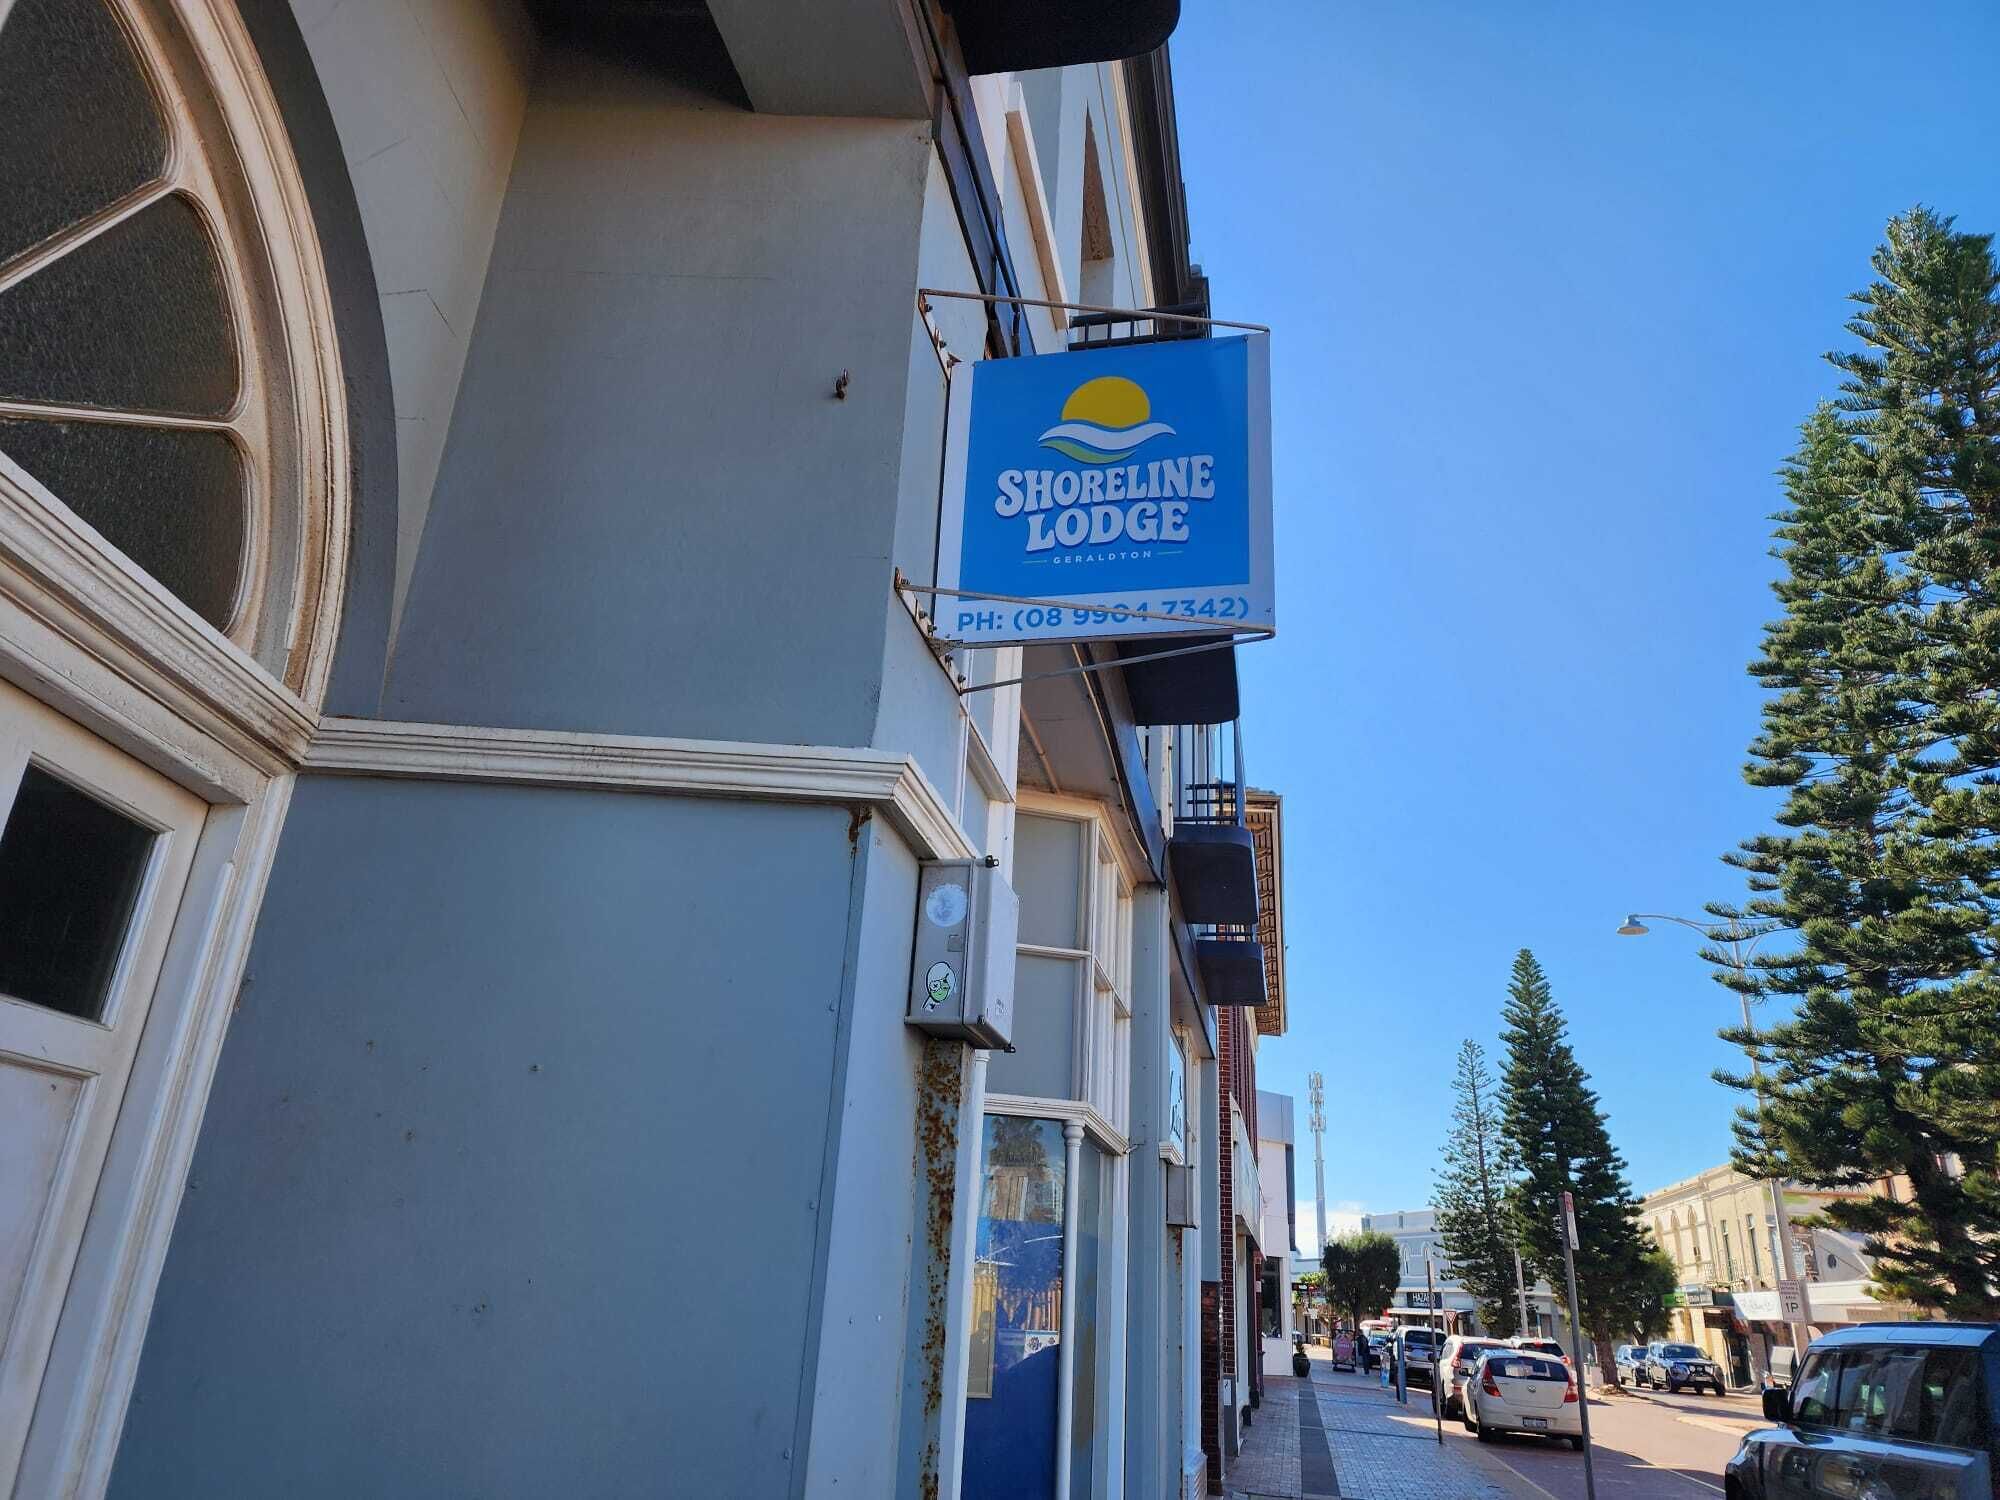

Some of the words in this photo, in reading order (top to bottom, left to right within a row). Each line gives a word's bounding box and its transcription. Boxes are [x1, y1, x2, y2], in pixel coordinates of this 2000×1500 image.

[995, 455, 1215, 517] SHORELINE
[1026, 501, 1189, 552] LODGE
[1053, 550, 1152, 564] GERALDTON
[958, 611, 1003, 632] PH:
[1013, 606, 1062, 631] (08
[1161, 596, 1249, 620] 7342)
